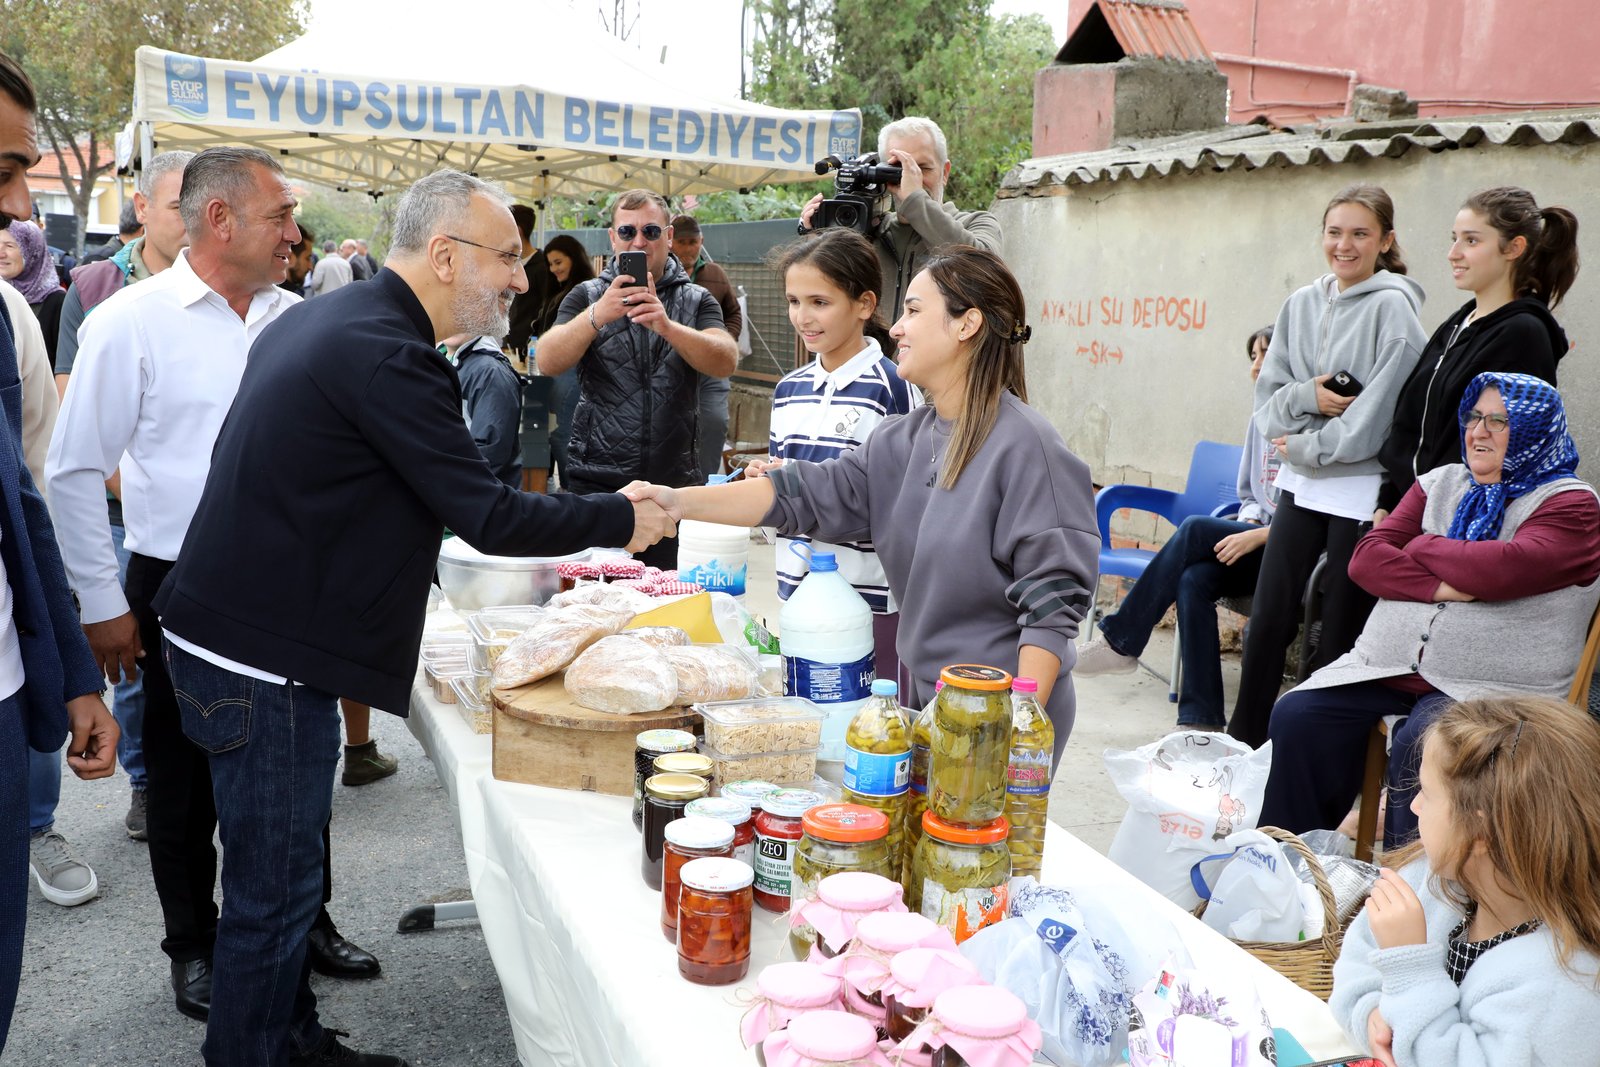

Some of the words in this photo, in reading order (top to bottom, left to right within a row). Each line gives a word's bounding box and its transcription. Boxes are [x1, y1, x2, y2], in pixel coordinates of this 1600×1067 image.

[171, 90, 204, 100] SULTAN
[225, 69, 545, 139] EYÜPSULTAN
[564, 97, 817, 165] BELEDİYESİ
[1101, 296, 1123, 326] SU
[1132, 296, 1207, 331] DEPOSU
[695, 570, 735, 587] Erikli
[763, 841, 783, 857] ZEO
